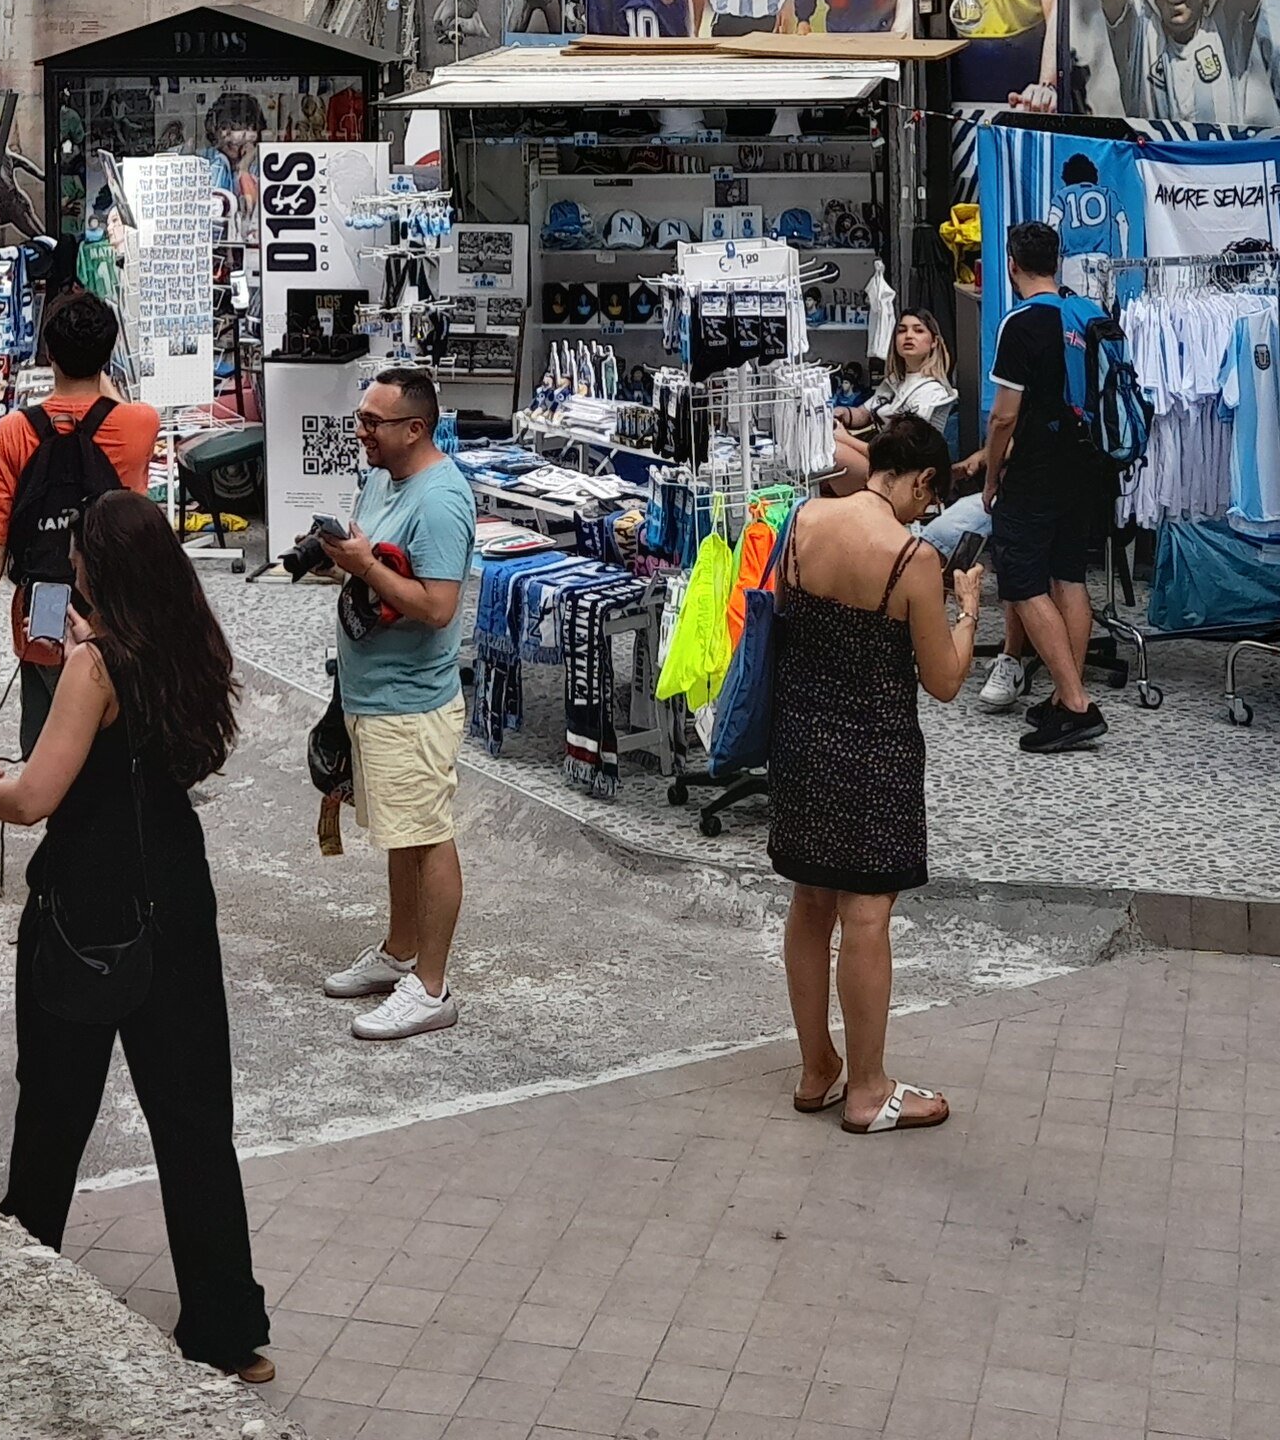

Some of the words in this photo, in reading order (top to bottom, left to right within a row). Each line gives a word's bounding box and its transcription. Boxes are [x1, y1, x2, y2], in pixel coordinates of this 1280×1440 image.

[1066, 189, 1108, 229] 10
[1154, 183, 1209, 211] AMORE
[1213, 185, 1265, 209] SENZA
[318, 152, 329, 271] ORIGINAL
[619, 217, 634, 233] N
[668, 223, 682, 236] N
